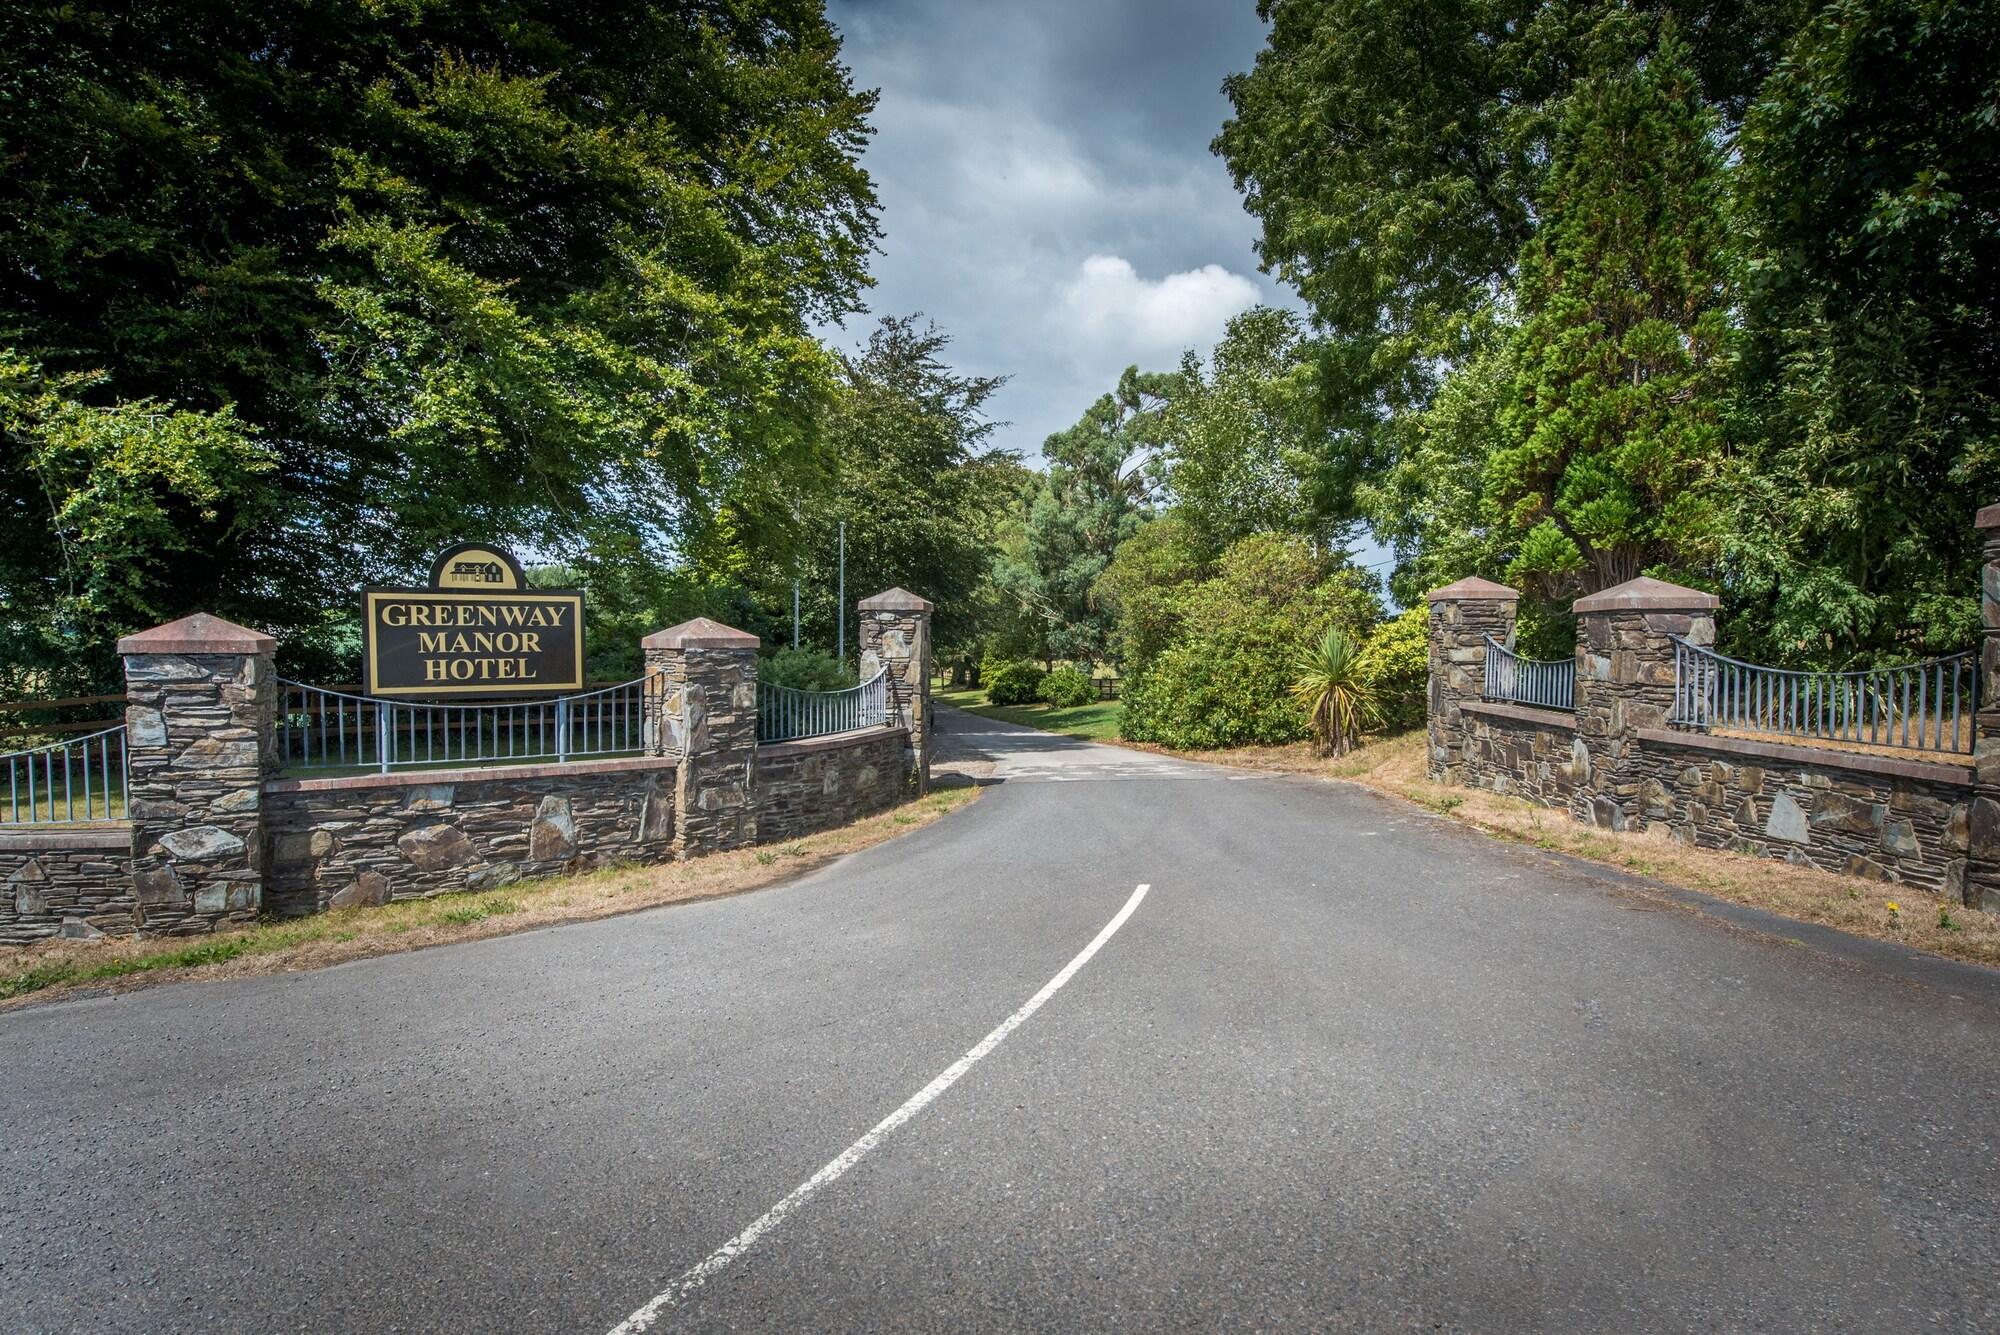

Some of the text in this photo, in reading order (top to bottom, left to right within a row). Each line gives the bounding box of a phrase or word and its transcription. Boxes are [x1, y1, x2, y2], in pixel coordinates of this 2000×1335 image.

[381, 604, 566, 627] GREENWAY
[417, 632, 542, 653] MANOR
[424, 658, 536, 681] HOTEL
